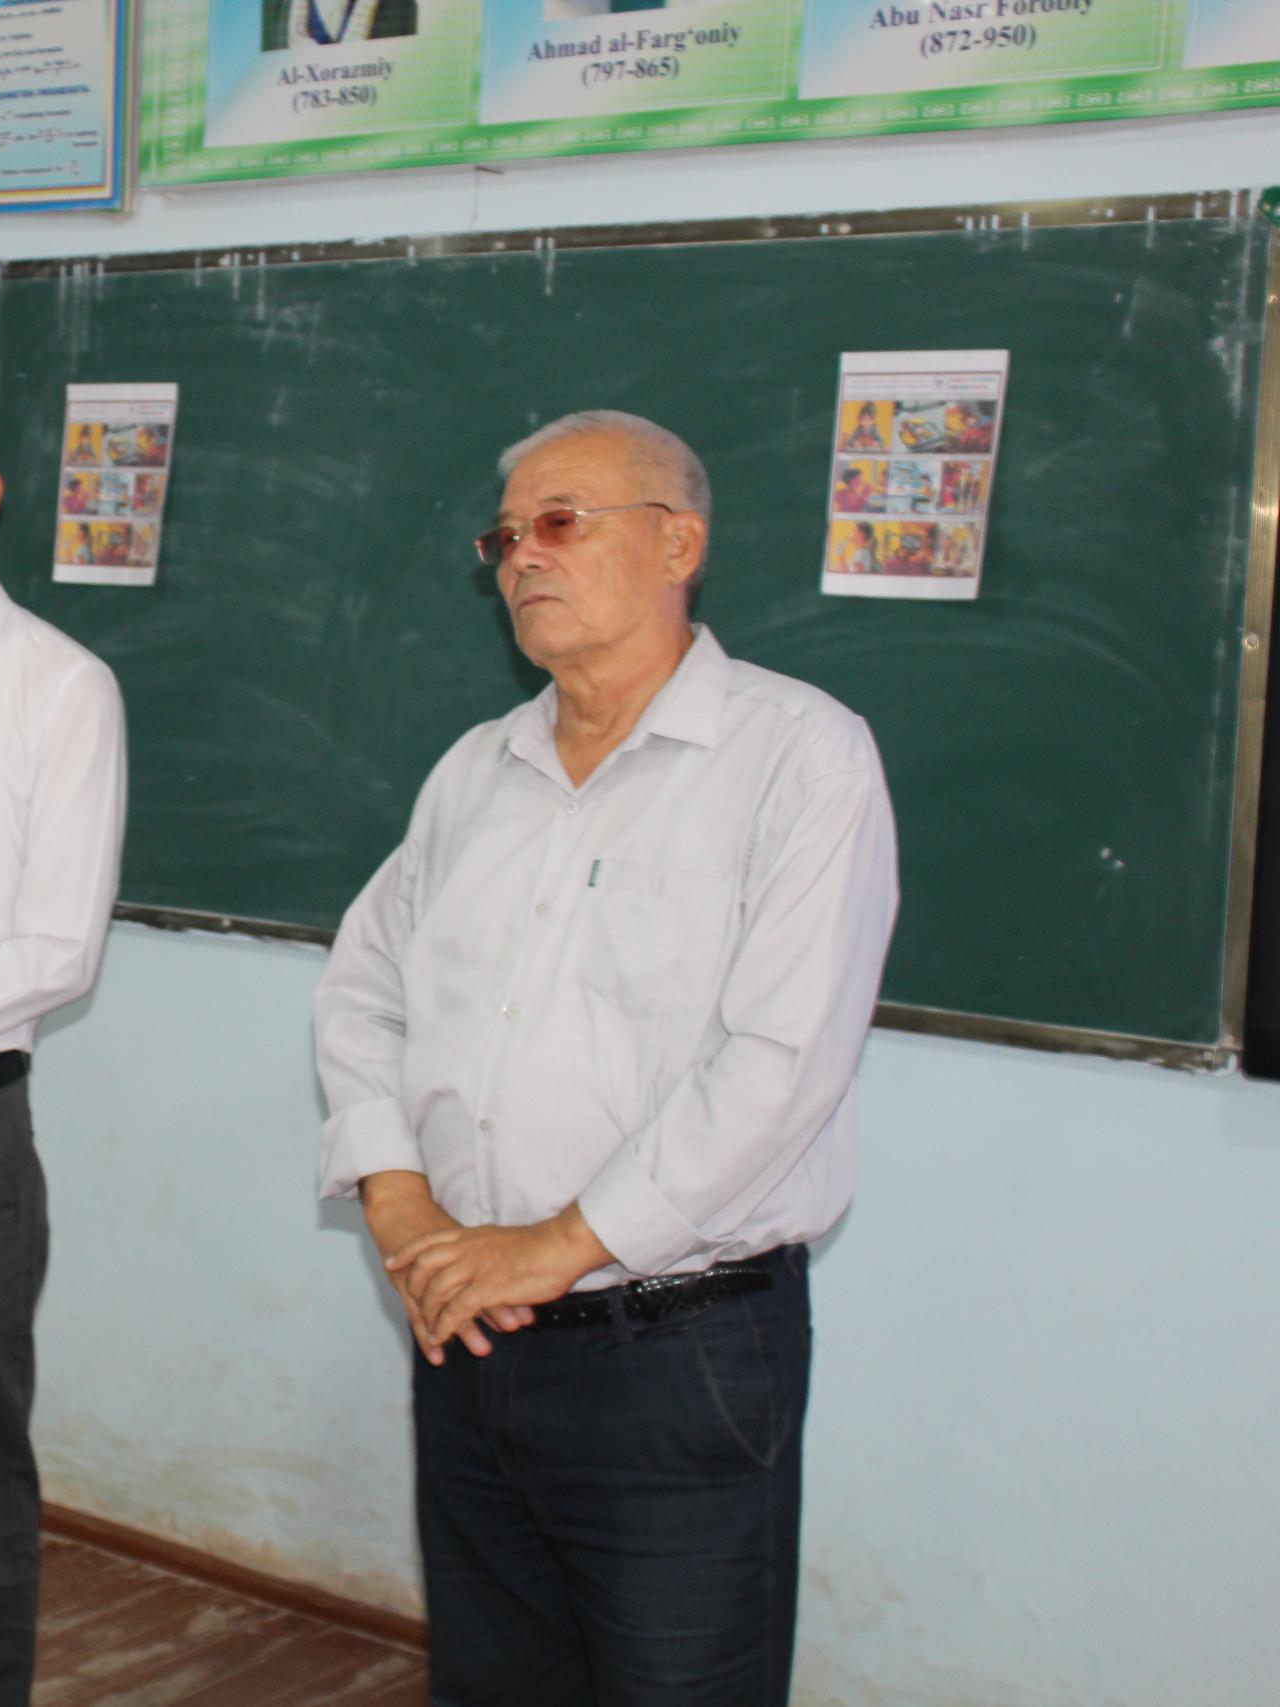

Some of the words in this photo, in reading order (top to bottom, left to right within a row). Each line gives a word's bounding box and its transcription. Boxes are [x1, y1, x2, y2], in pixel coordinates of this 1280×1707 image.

[869, 6, 919, 29] Abu
[927, 1, 988, 23] Nasr
[528, 35, 602, 60] Ahmad
[919, 23, 1037, 60] (872-950)
[277, 58, 394, 85] Al-Xorazmiy
[581, 56, 680, 88] (797-865)
[292, 85, 377, 113] (783-850)
